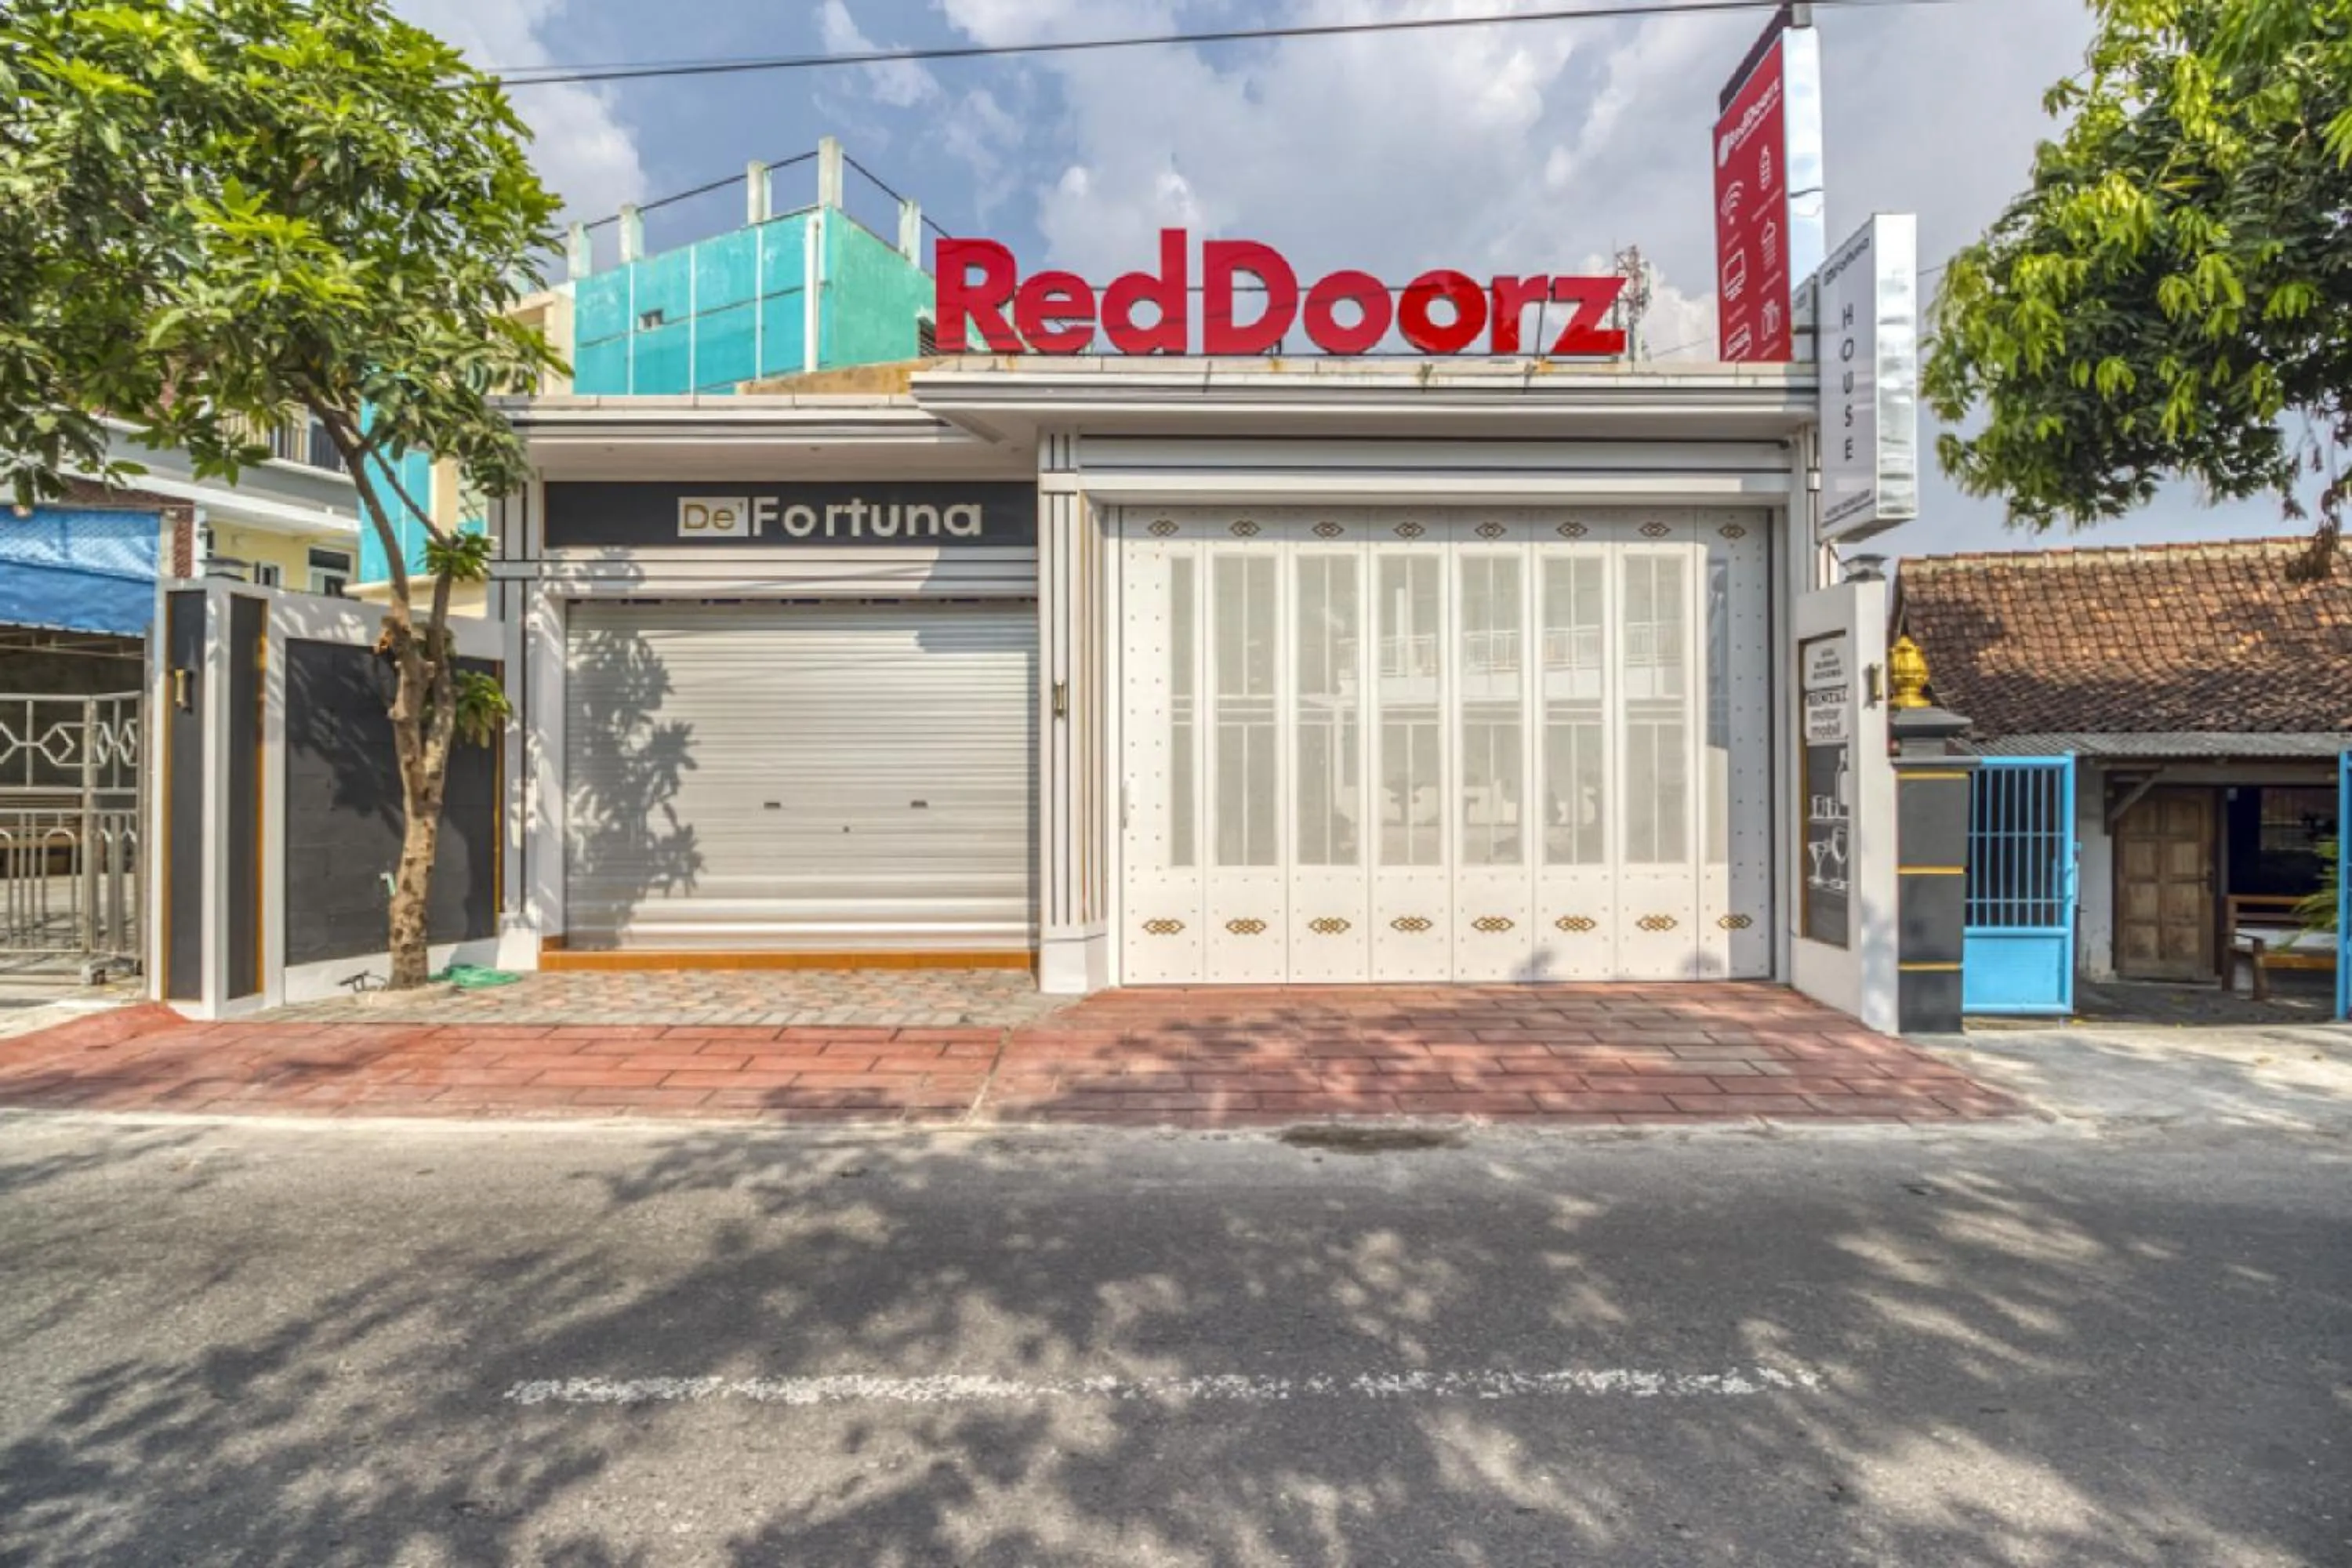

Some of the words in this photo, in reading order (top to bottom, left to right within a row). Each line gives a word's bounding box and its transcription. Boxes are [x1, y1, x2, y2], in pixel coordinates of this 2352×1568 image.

[935, 228, 1628, 356] RedDoorz
[1840, 303, 1854, 462] HOUSE
[753, 496, 983, 538] Fortuna
